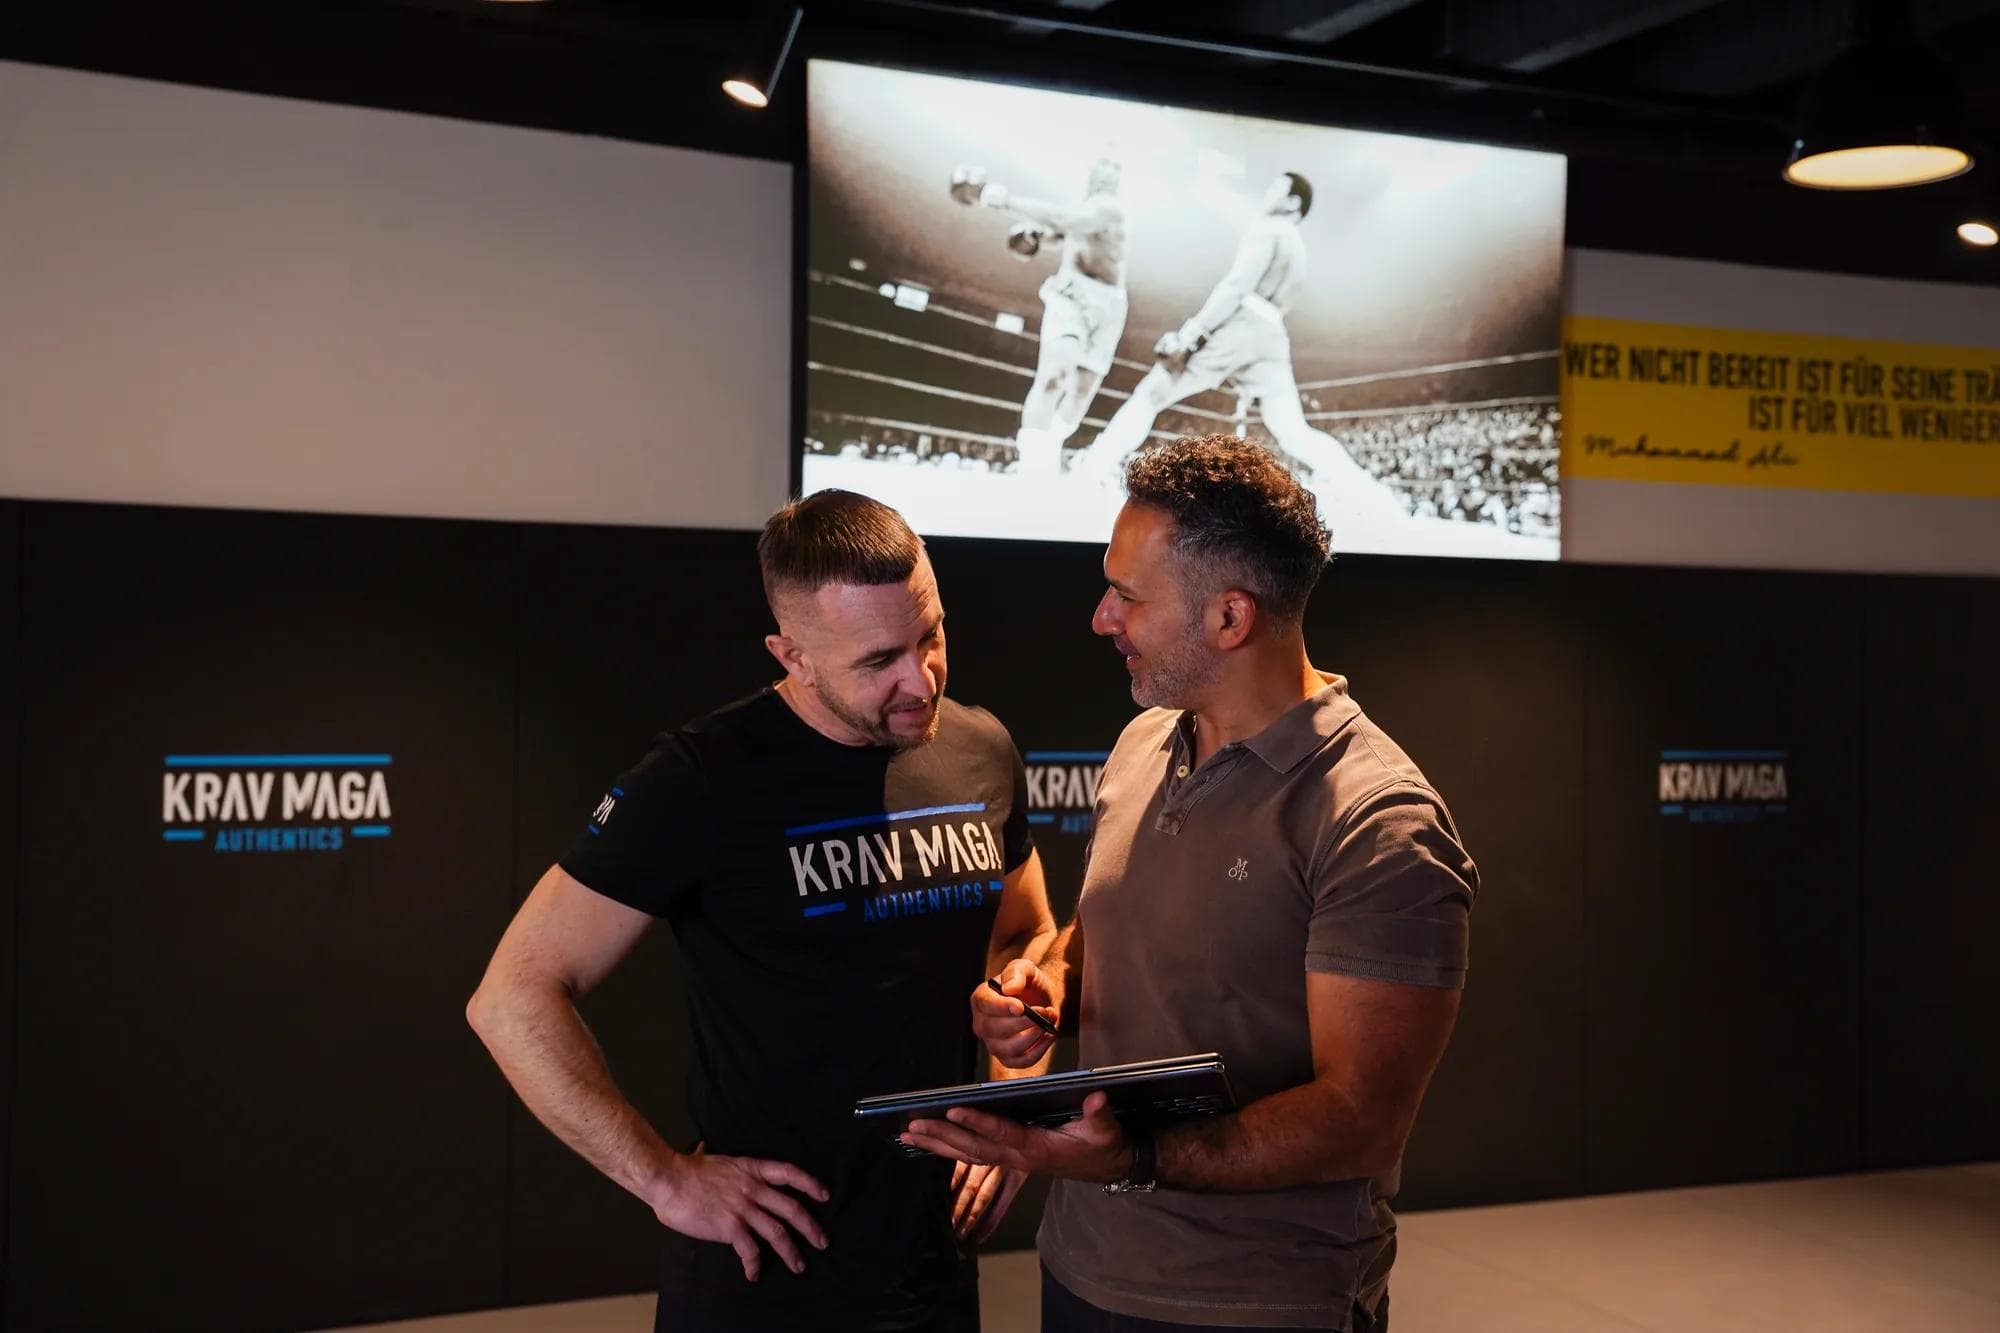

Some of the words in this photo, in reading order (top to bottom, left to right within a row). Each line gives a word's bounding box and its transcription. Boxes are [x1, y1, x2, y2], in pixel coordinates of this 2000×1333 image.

[1565, 341, 1620, 380] WER
[1629, 346, 1701, 386] NICHT
[1708, 352, 1790, 391] BEREIT
[1798, 359, 1832, 394] IST
[1840, 354, 1884, 397] FÜR
[1893, 364, 1953, 402] SEINE
[1748, 396, 1784, 431] IST
[1792, 396, 1836, 433] FÜR
[1844, 401, 1891, 438] VIEL
[1901, 407, 2000, 445] WENIGER
[163, 771, 275, 822] KRAV
[282, 771, 391, 820] MAGA
[1025, 765, 1104, 808] KRAV
[1659, 762, 1722, 801] KRAV
[1725, 762, 1788, 800] MAGA
[214, 827, 344, 852] AUTHENTICS
[788, 831, 903, 897] KRAV
[910, 821, 1002, 878] MAGA
[863, 881, 985, 923] AUTHENTICS
